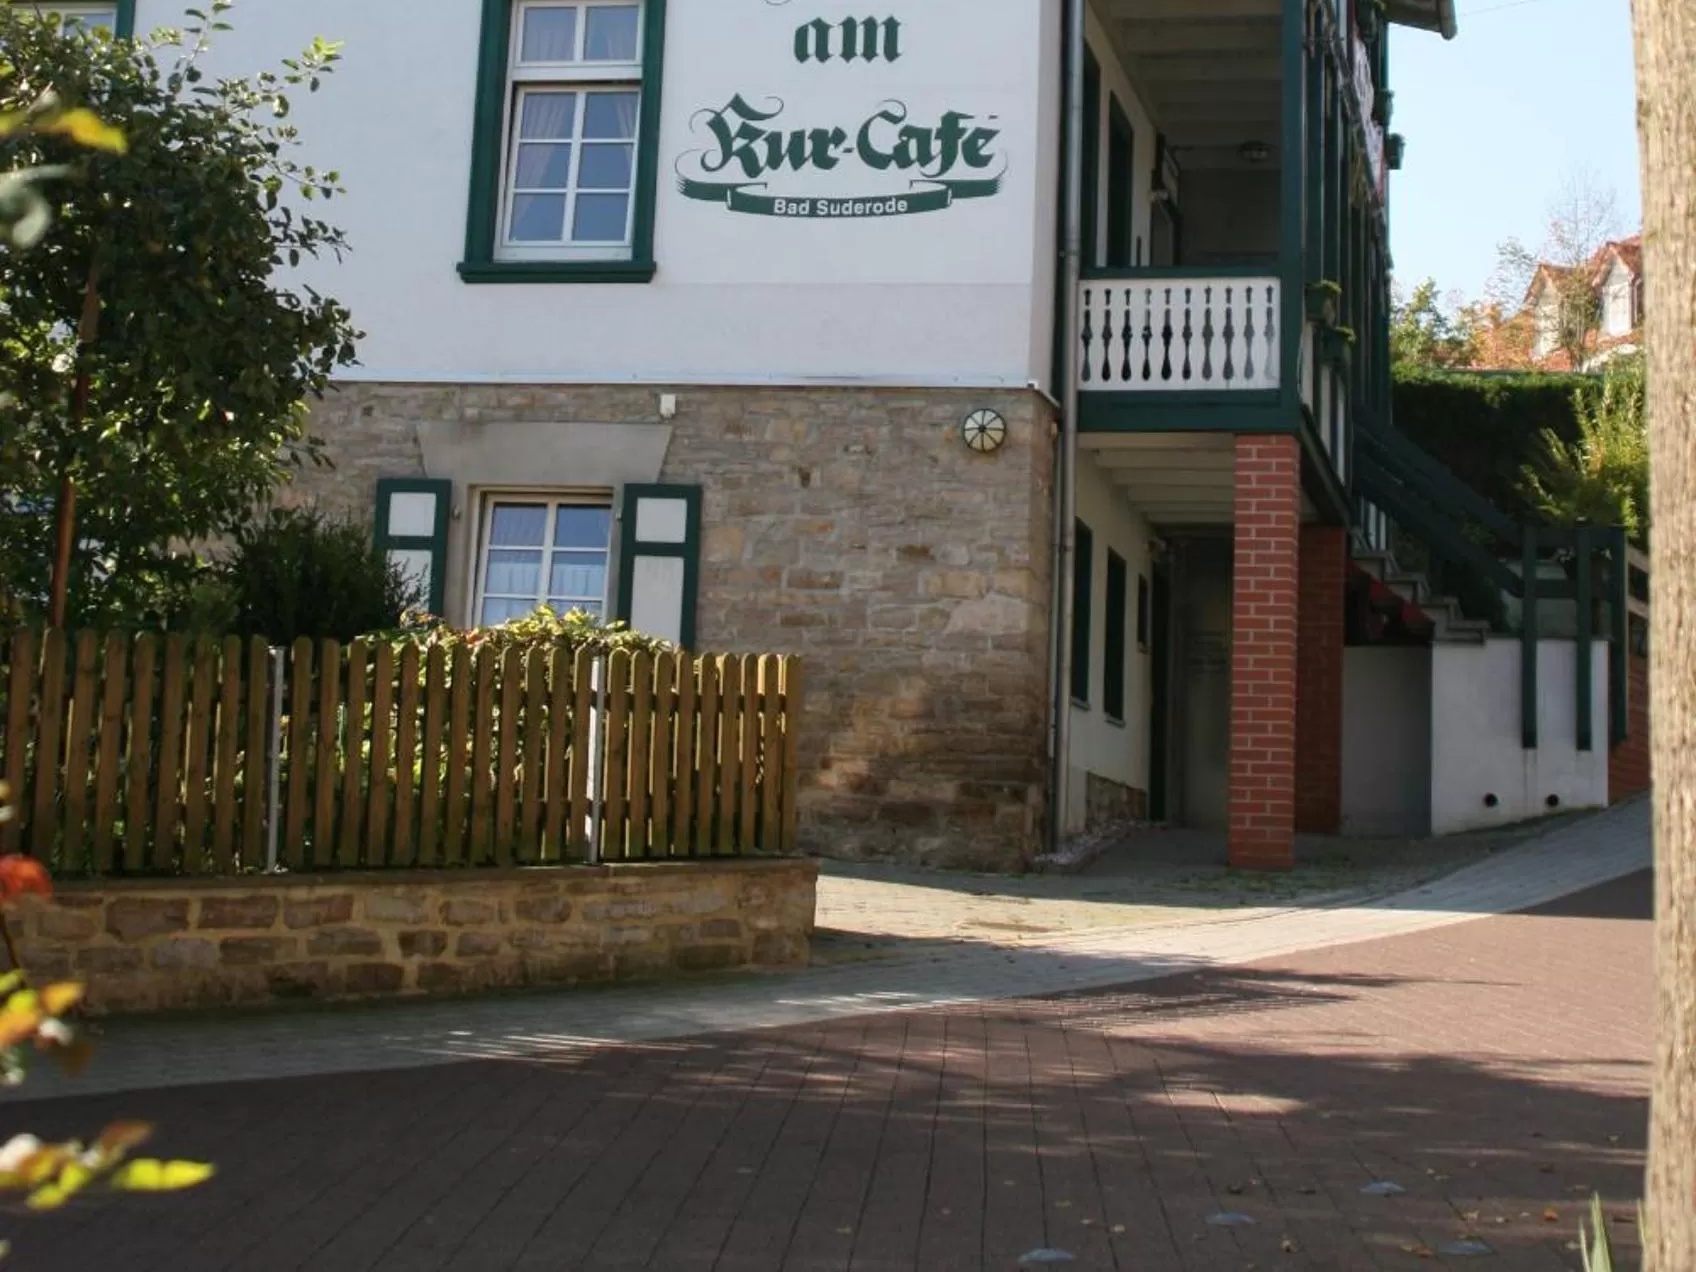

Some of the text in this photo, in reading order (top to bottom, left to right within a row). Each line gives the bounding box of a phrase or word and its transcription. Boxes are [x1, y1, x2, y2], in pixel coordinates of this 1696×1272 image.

[793, 15, 902, 64] am
[773, 198, 908, 215] Bad Suderode
